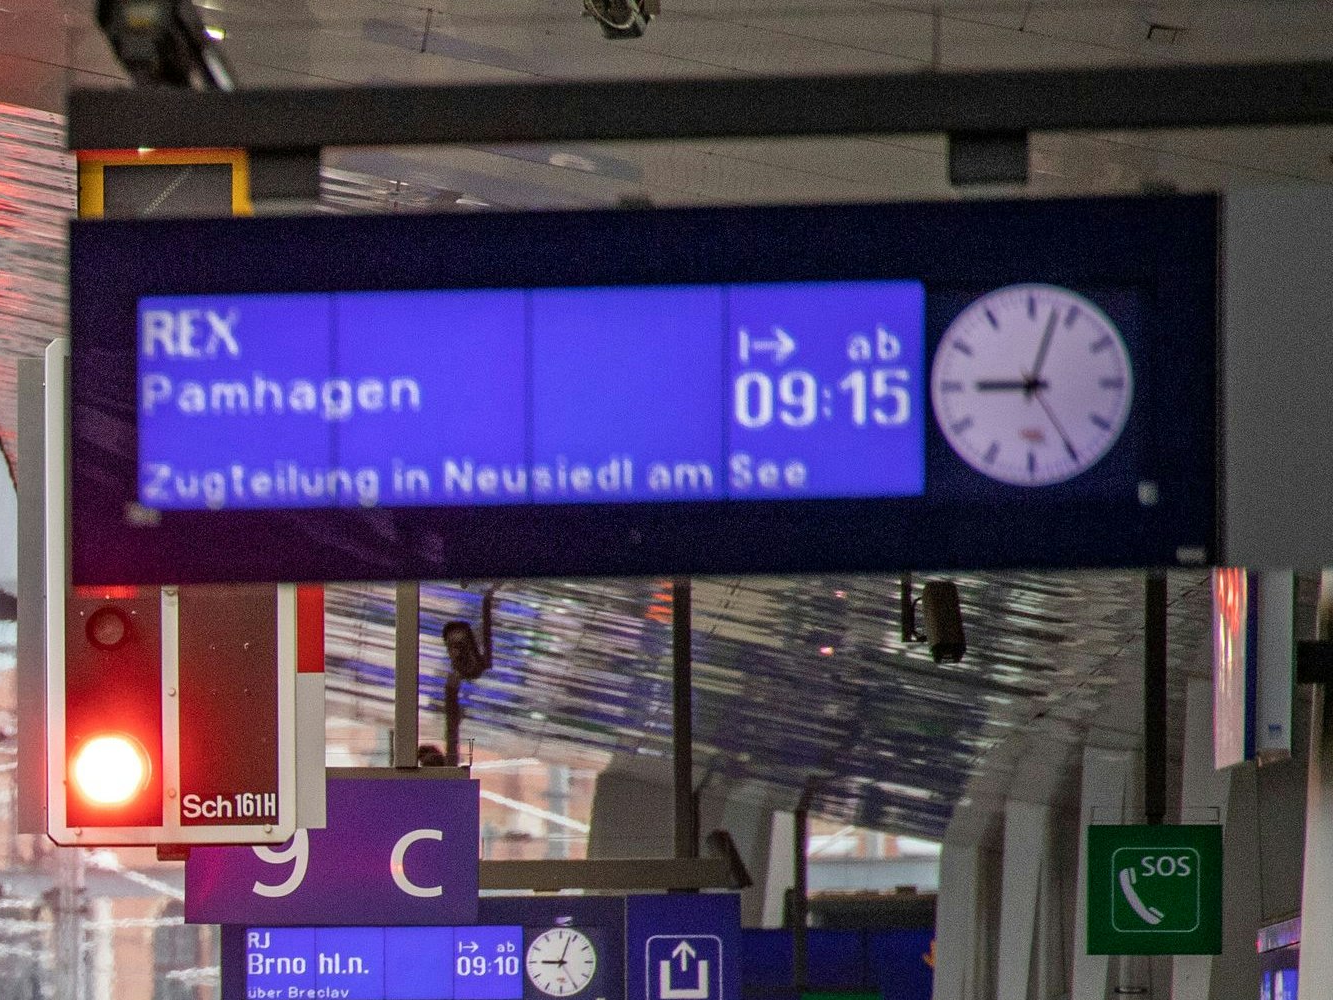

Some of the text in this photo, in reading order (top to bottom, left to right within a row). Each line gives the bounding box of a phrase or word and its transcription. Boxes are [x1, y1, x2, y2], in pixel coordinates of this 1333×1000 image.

[141, 309, 239, 357] REX
[846, 324, 902, 362] ab
[141, 371, 421, 422] Pamhagen
[734, 370, 912, 429] 09:15
[141, 452, 808, 510] Zugteilung in Neusiedl am See
[390, 828, 443, 898] C
[1141, 856, 1191, 877] SOS
[247, 932, 271, 949] RJ
[496, 941, 515, 953] ab
[247, 952, 369, 975] Brno hl.n.
[456, 956, 520, 976] 09:10
[247, 986, 349, 999] über Breclav
